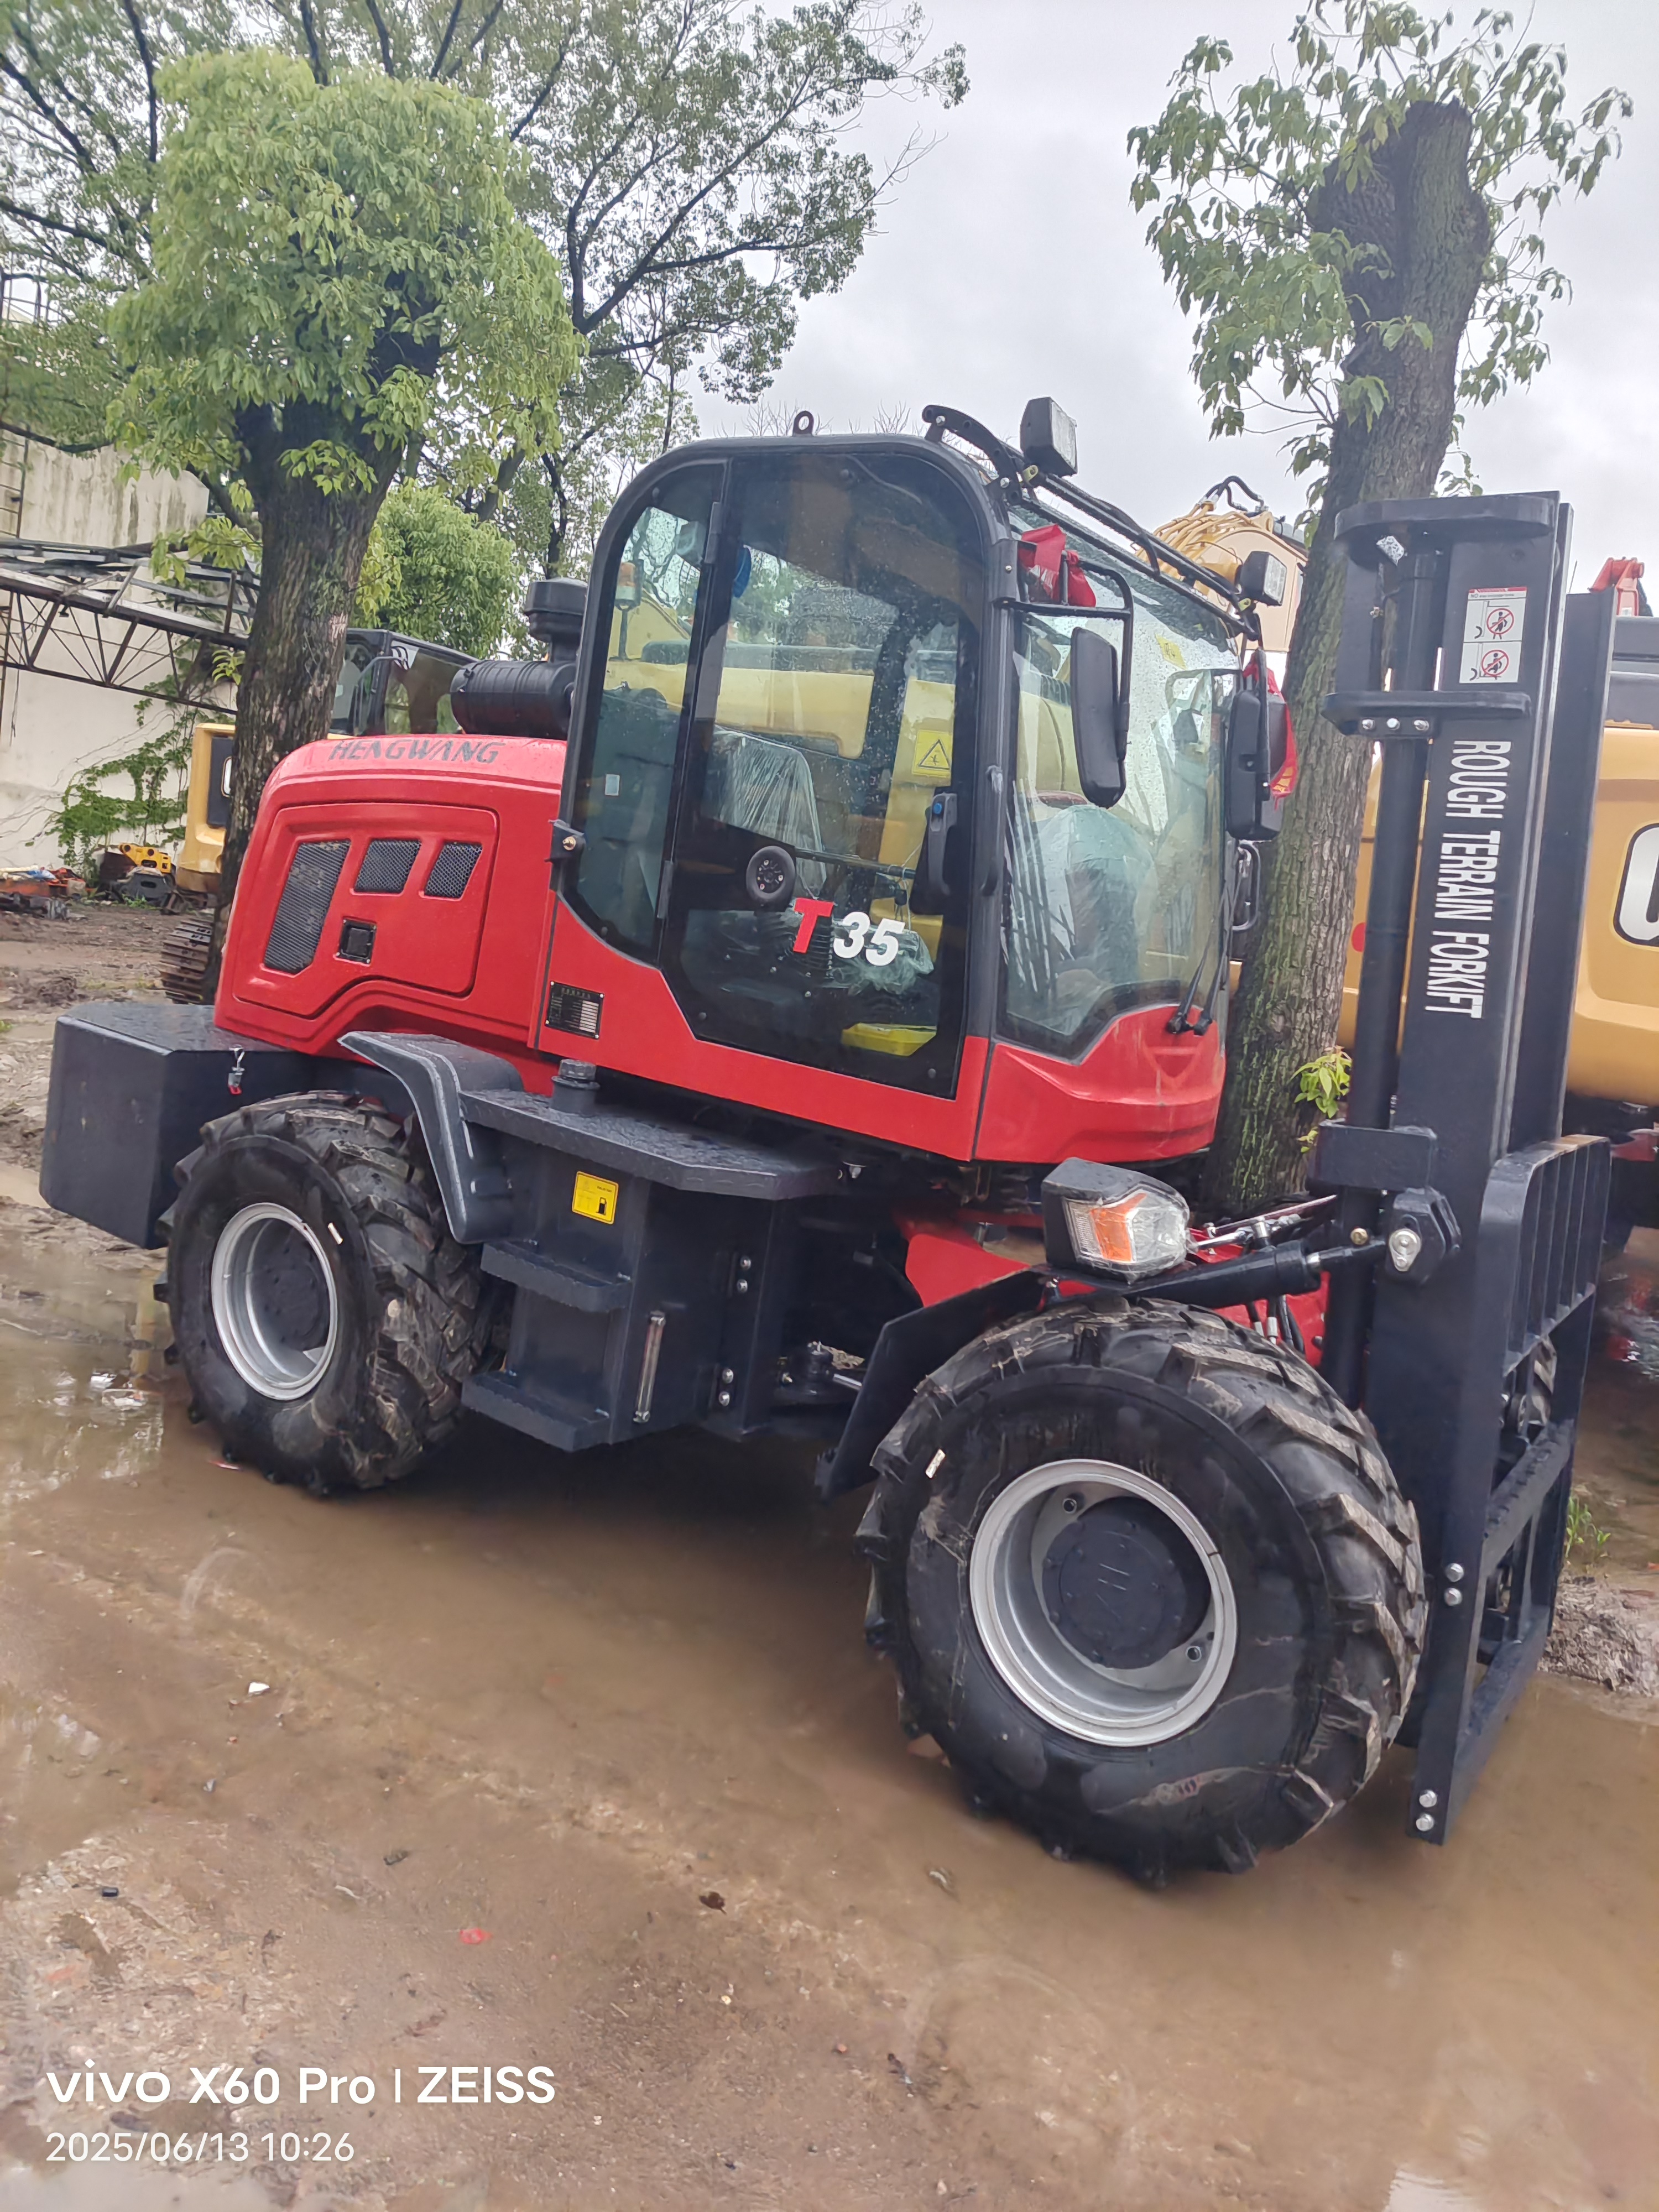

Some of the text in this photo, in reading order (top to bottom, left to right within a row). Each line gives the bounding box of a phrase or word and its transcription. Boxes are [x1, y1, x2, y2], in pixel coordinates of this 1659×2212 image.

[328, 739, 506, 764] HENGWANG
[1424, 740, 1512, 1019] ROUGH TERRAIN FORKIFT
